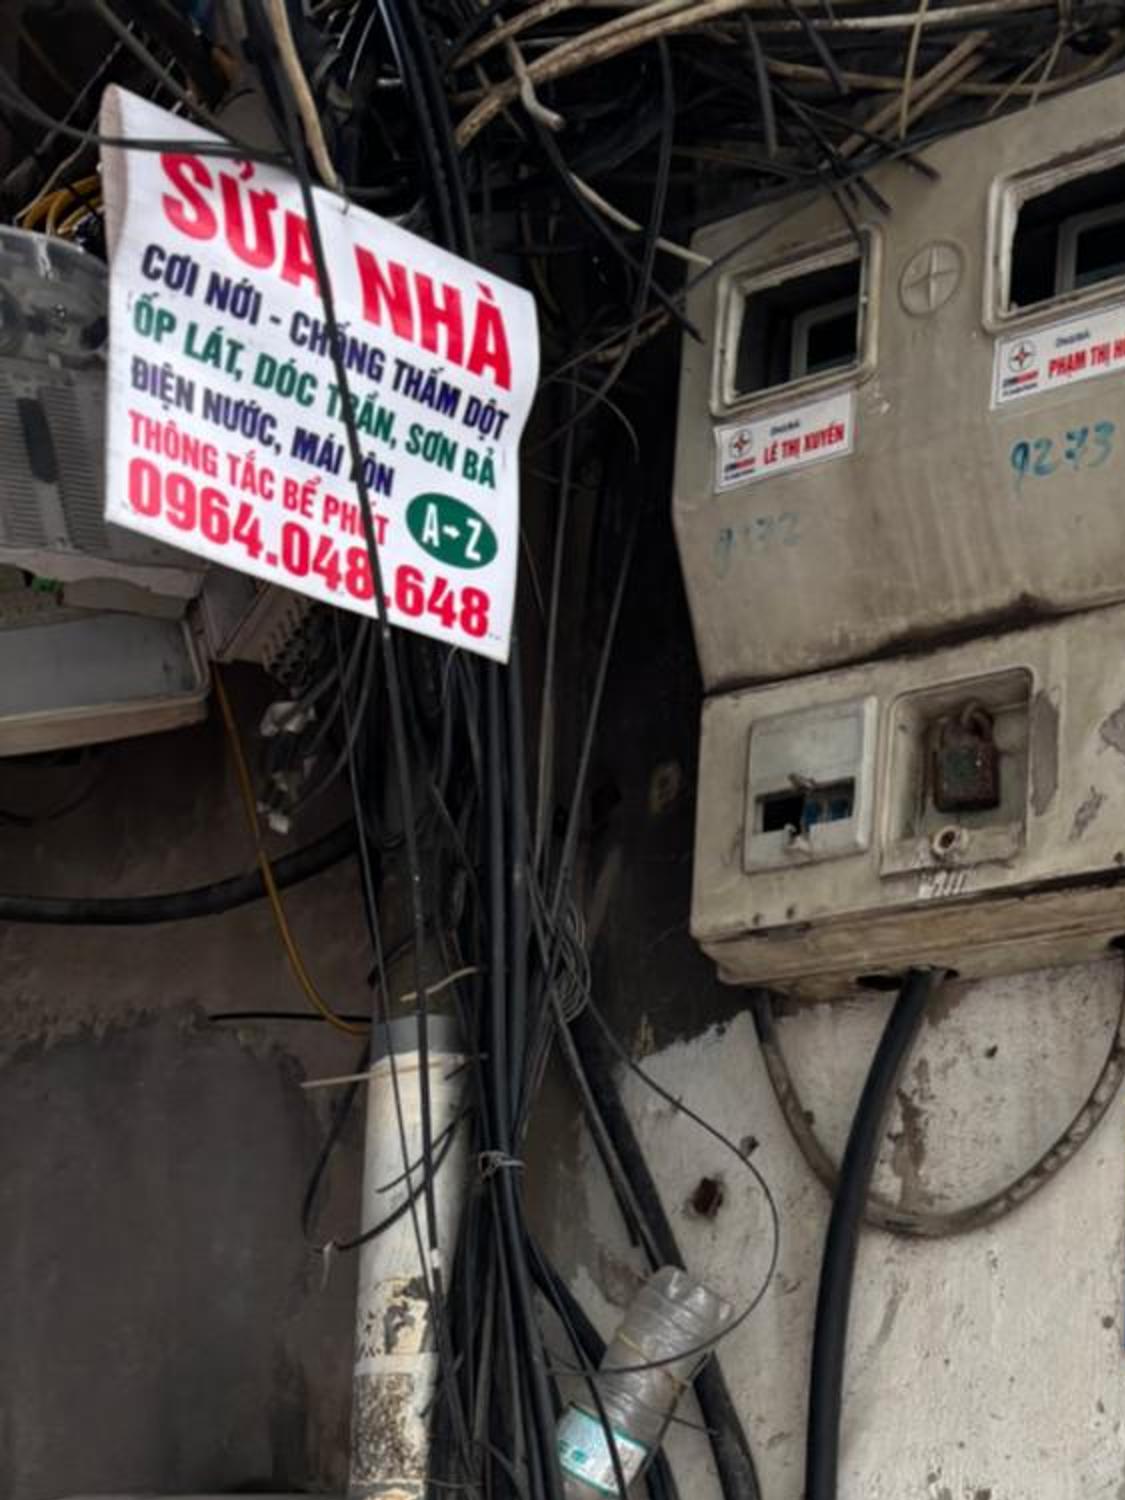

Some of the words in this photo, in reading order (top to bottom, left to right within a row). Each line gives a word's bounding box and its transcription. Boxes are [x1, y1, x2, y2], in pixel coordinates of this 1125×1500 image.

[141, 243, 200, 298] CƠI
[203, 270, 262, 326] NỚI
[391, 357, 462, 419] THẤM
[462, 396, 509, 442] DỘT
[160, 150, 325, 299] SỬA
[353, 243, 512, 392] NHÀ
[128, 408, 219, 479] THÔNG
[226, 450, 276, 502] TẮC
[282, 475, 322, 520] BỂ
[131, 354, 196, 415] ĐIỆN
[202, 387, 283, 456] NƯỚC,
[290, 426, 345, 477] MÁI
[133, 291, 177, 343] ỐP
[183, 320, 245, 382] LÁT,
[253, 351, 318, 407] DÓC
[405, 423, 459, 472] SƠN
[462, 446, 497, 490] BẢ
[128, 456, 491, 639] 0964.048.648
